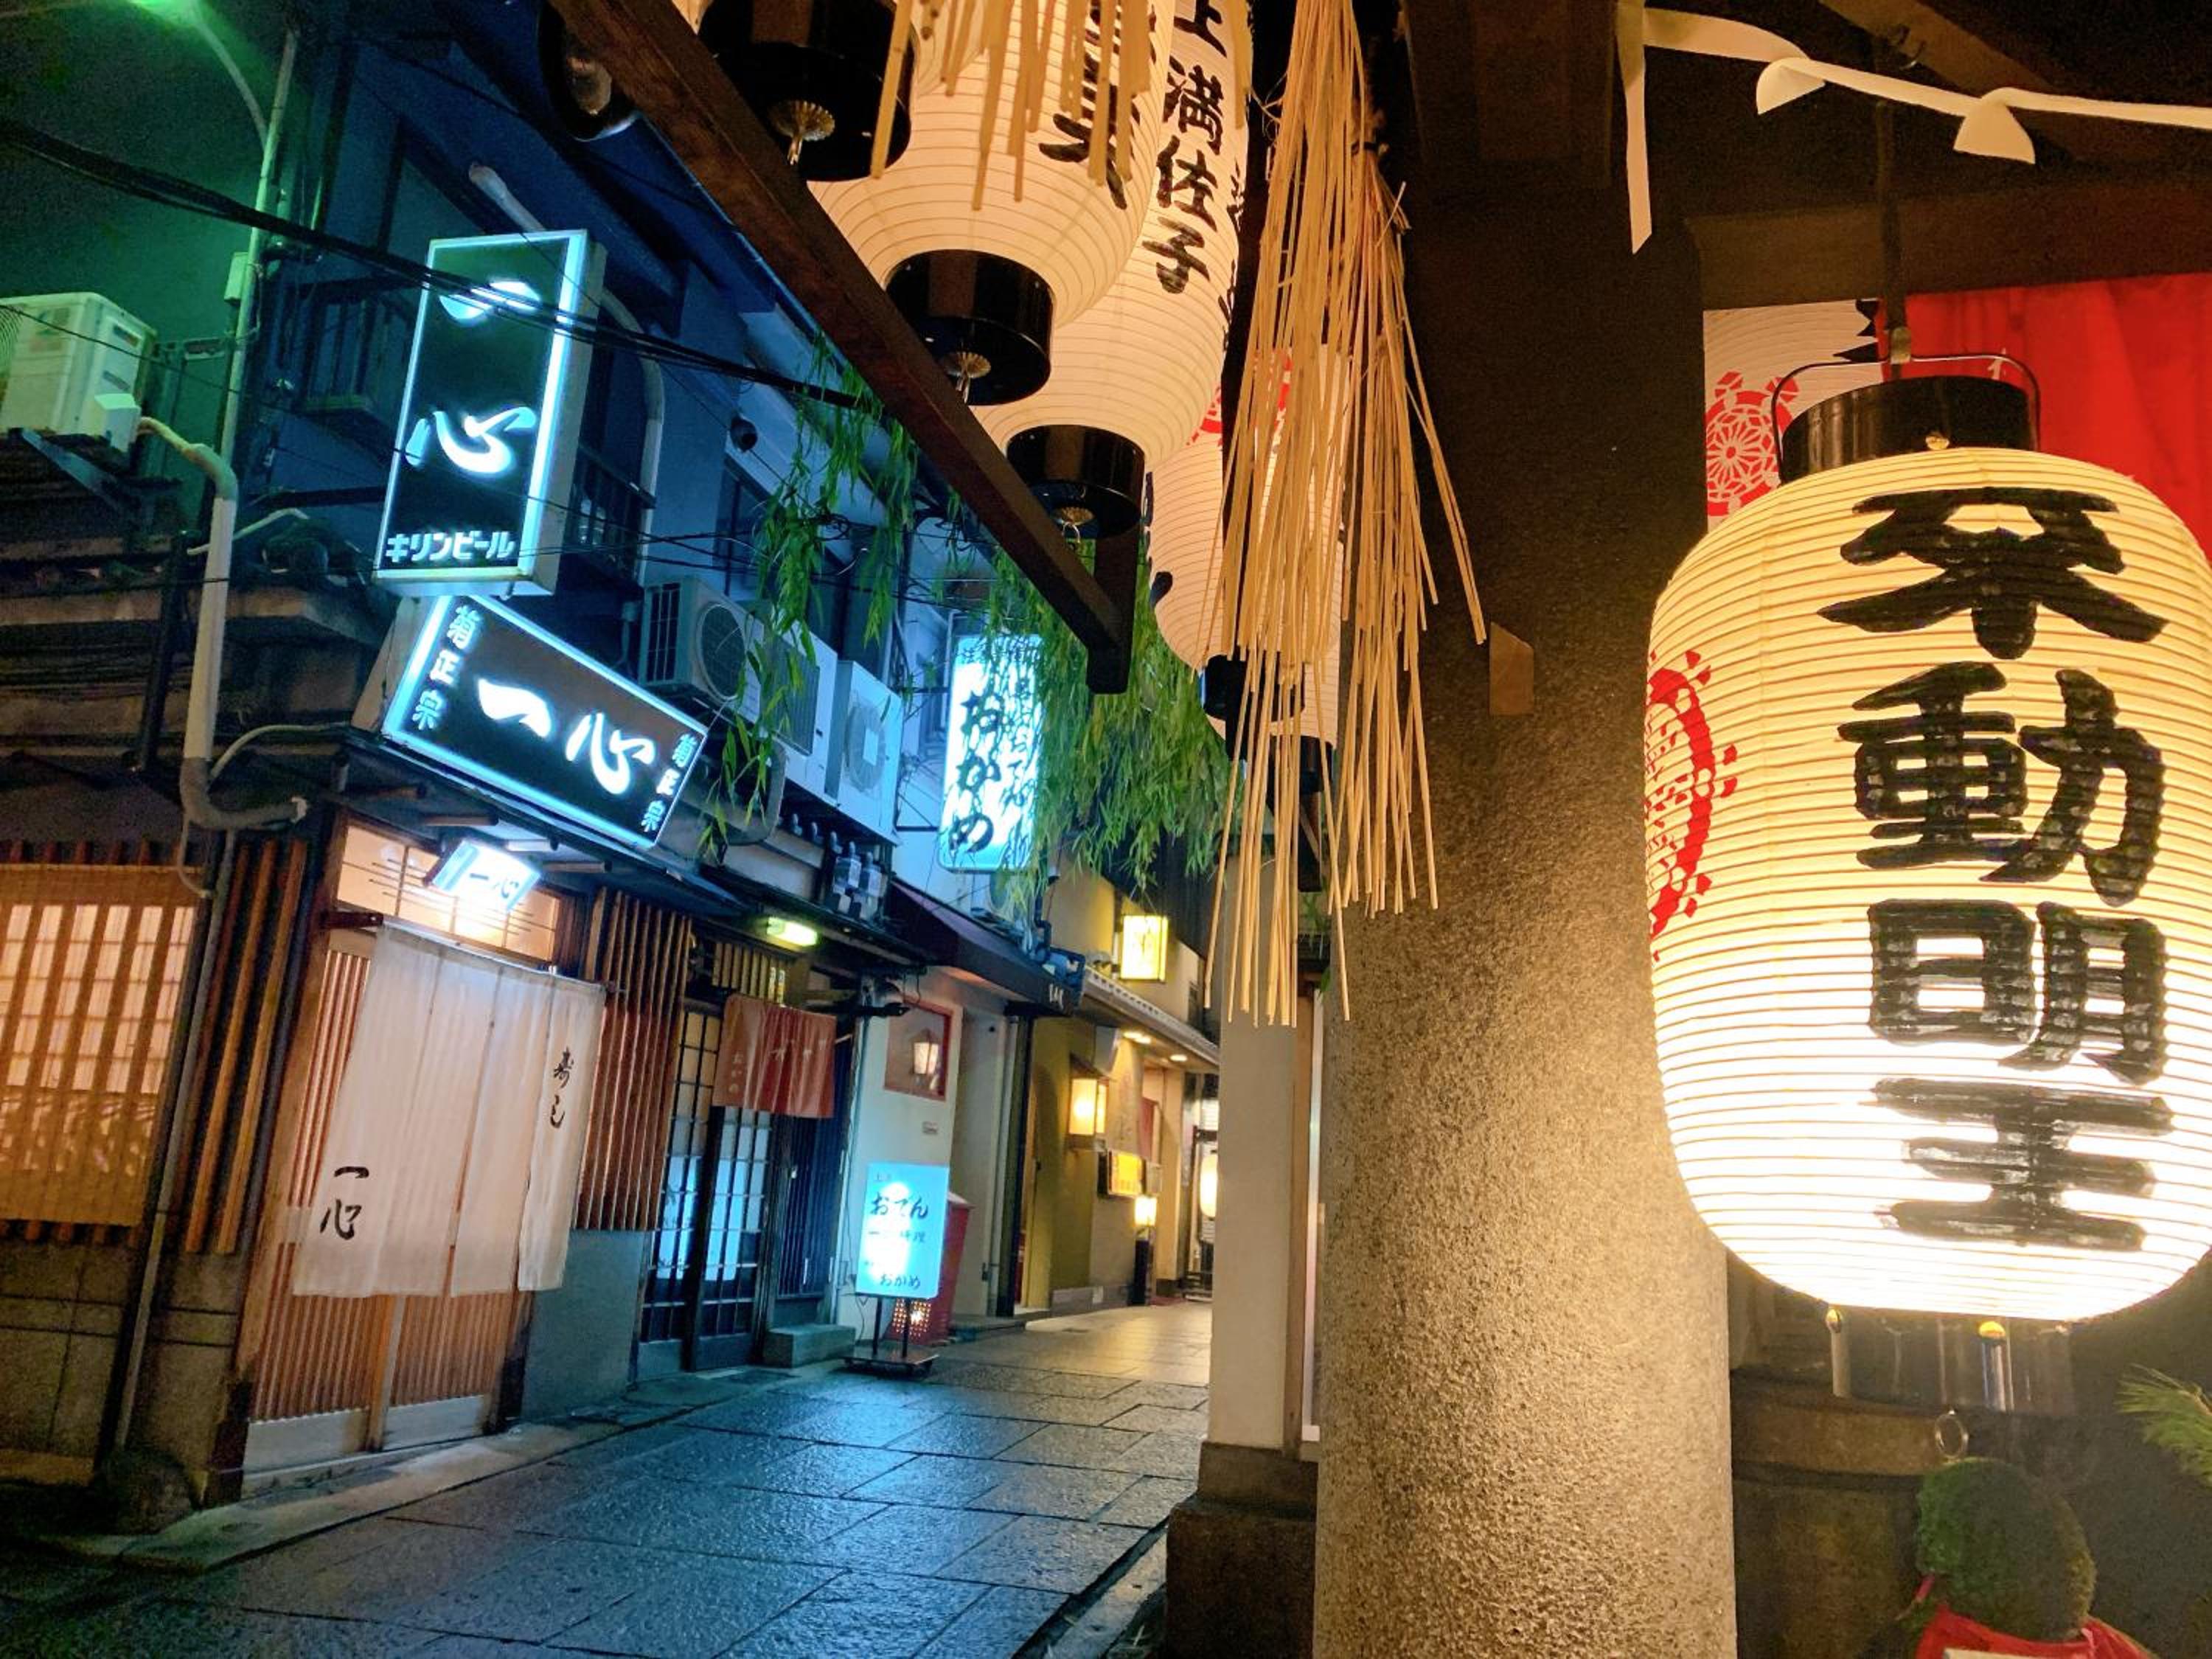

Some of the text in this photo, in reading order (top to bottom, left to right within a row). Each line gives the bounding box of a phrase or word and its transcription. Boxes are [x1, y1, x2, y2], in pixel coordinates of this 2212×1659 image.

[405, 279, 543, 475] 一心
[386, 530, 516, 564] キリンビール
[477, 677, 657, 796] 一心
[1818, 487, 2174, 1251] 不動明王
[319, 1166, 370, 1240] 一心
[869, 1191, 929, 1220] おでん
